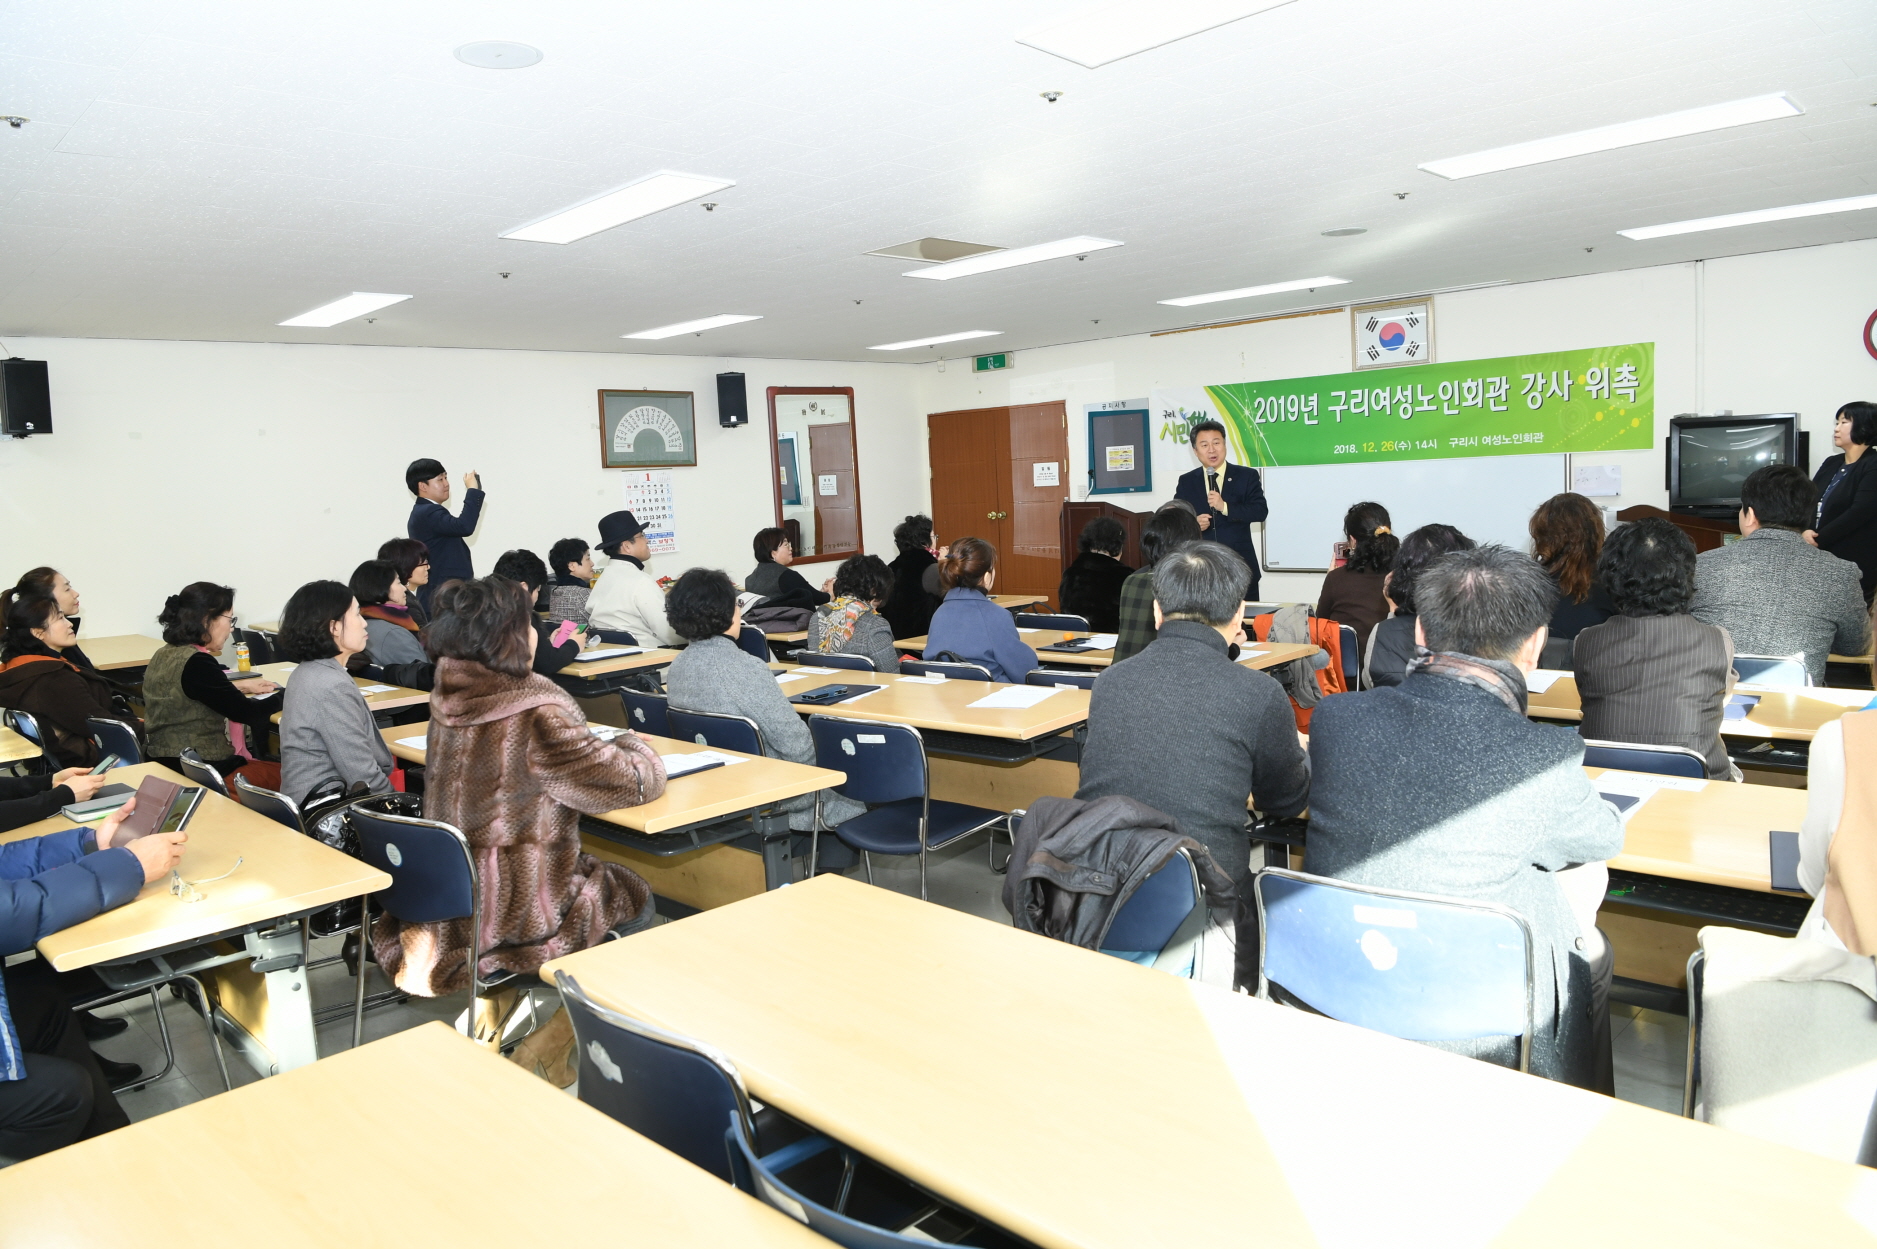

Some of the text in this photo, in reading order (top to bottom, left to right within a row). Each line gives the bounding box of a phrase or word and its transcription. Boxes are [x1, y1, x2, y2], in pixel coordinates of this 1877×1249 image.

[1253, 363, 1640, 425] 2019년 구리여성노인회관 강사 위촉
[1333, 432, 1544, 455] 2018. 12. 26(수) 14시 구리시 여성노인회관
[645, 473, 651, 481] 1
